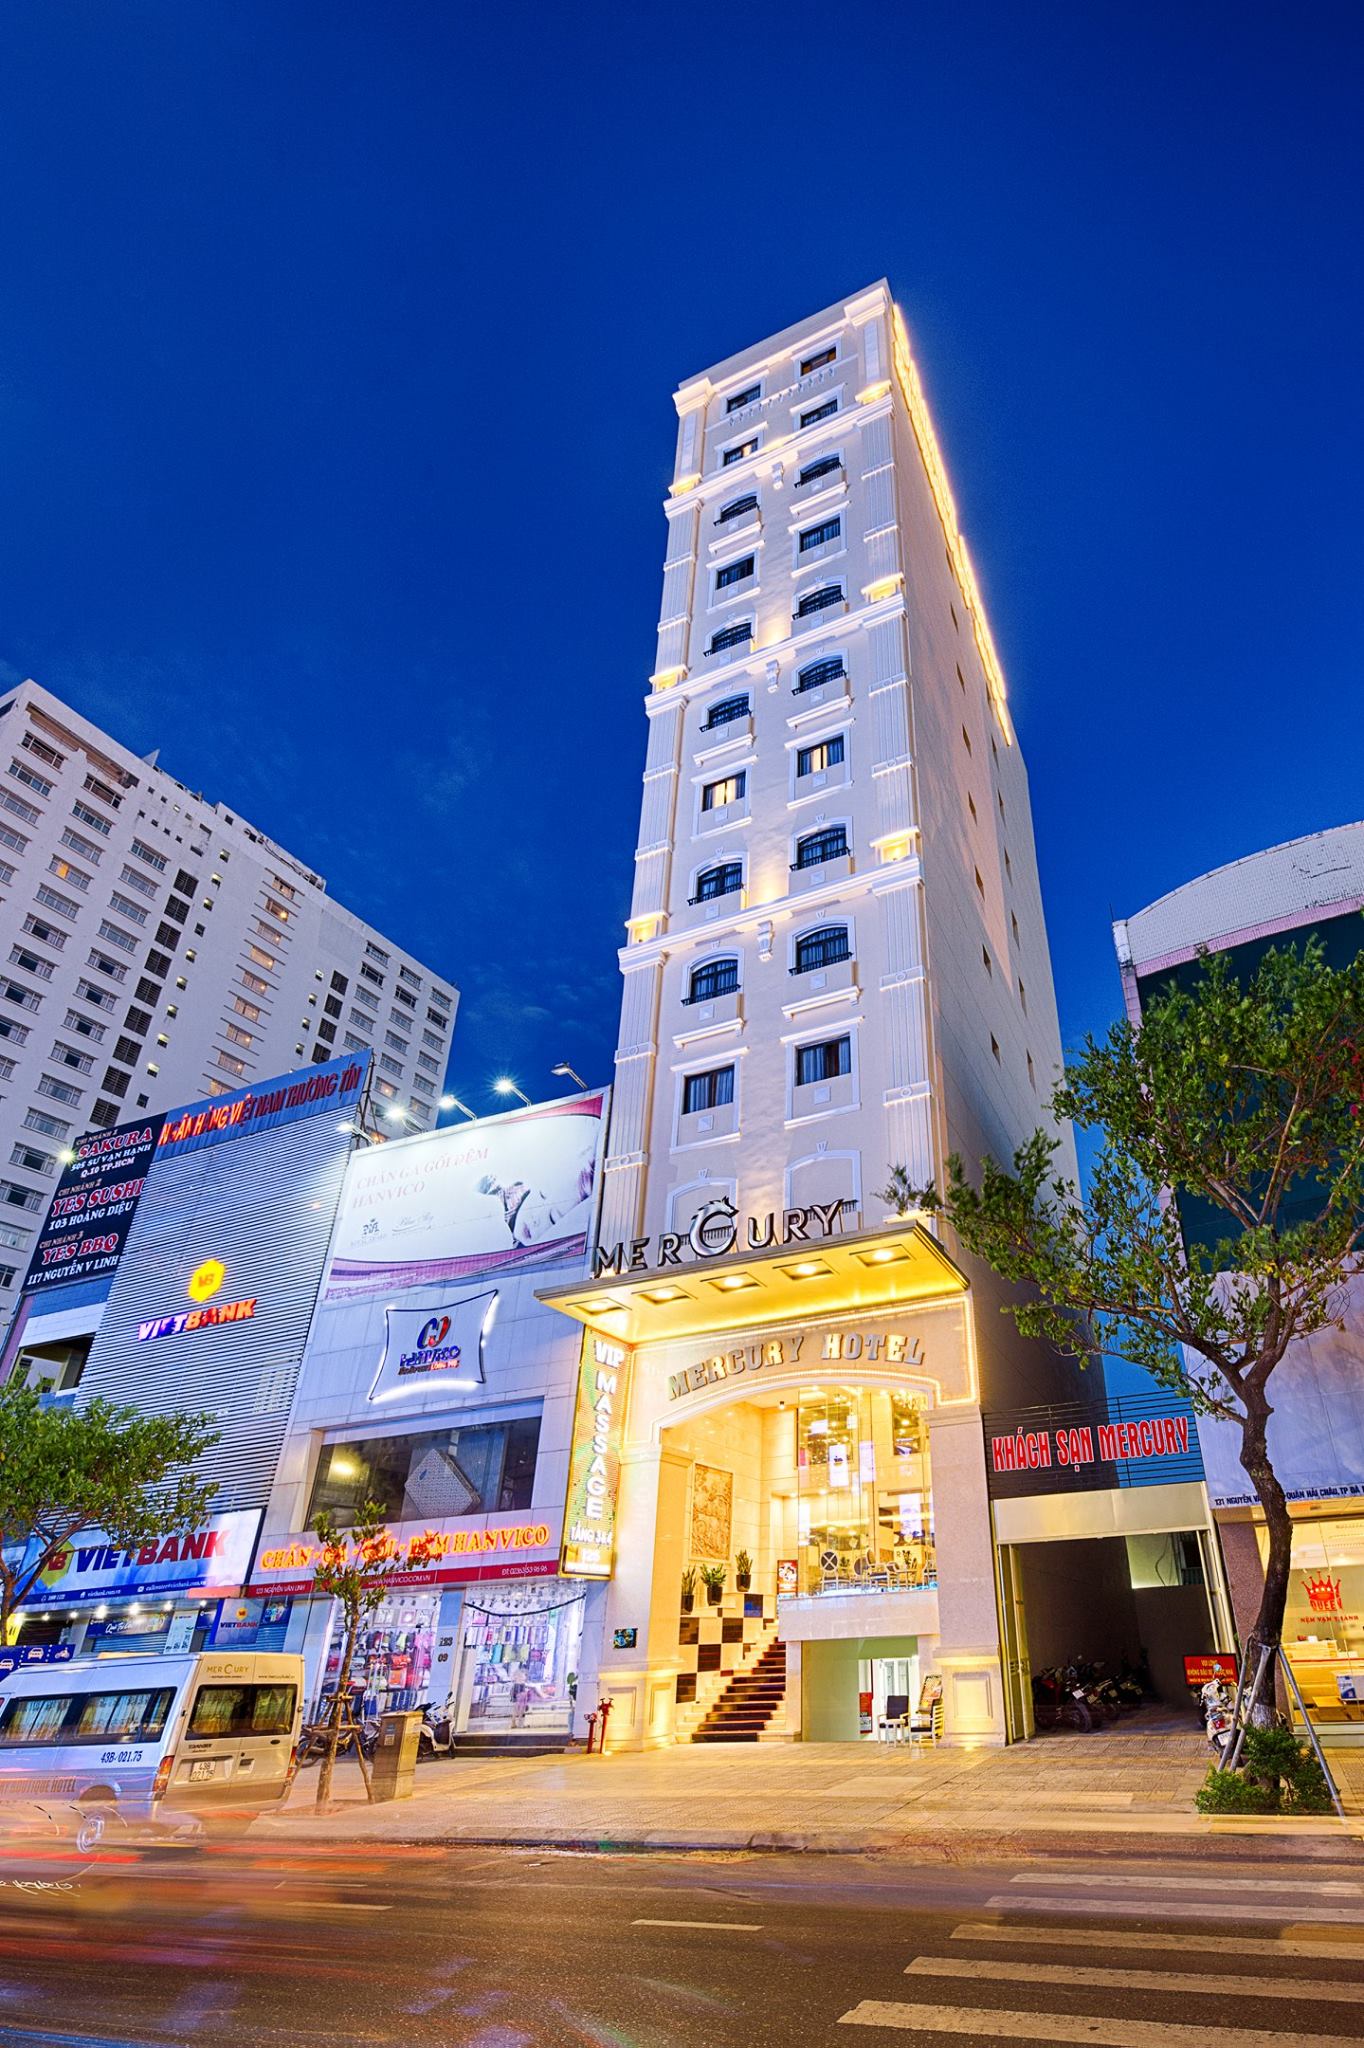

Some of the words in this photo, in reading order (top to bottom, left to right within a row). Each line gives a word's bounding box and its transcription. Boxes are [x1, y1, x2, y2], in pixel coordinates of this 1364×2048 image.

[158, 1113, 192, 1146] NGÂN
[192, 1106, 228, 1137] HÀNG
[229, 1093, 256, 1127] VIỆT
[255, 1089, 288, 1118] NAM
[286, 1073, 338, 1108] THƯƠNG
[338, 1062, 363, 1093] TÍN
[77, 1127, 153, 1160] SAKURA
[80, 1166, 100, 1178] Q.10
[101, 1156, 136, 1172] TP.HCM
[51, 1192, 87, 1217] YES
[87, 1177, 146, 1208] SUSHI
[352, 1180, 426, 1210] HANVICO
[48, 1218, 68, 1231] 103
[106, 1200, 134, 1216] DIỆU
[42, 1242, 79, 1266] YES
[78, 1233, 119, 1257] BBQ
[593, 1195, 845, 1279] MERCURY
[27, 1272, 43, 1286] 117
[43, 1259, 85, 1282] NGUYỄN
[93, 1255, 120, 1270] LINH
[138, 1297, 257, 1341] VIETBANK
[593, 1339, 626, 1369] VIP
[667, 1335, 805, 1401] MERCURY
[821, 1332, 926, 1366] HOTEL
[584, 1370, 617, 1520] MASSAGE
[991, 1426, 1052, 1473] KHÁCH
[1055, 1426, 1095, 1473] SẠN
[1096, 1416, 1191, 1462] MERCURY
[76, 1530, 231, 1573] VIETBANK
[452, 1524, 550, 1554] HANVICO
[220, 1621, 258, 1629] VIETBANK
[206, 1663, 250, 1675] MERCURY
[100, 1750, 144, 1764] 43B-021.75
[50, 1779, 77, 1793] HOTEL
